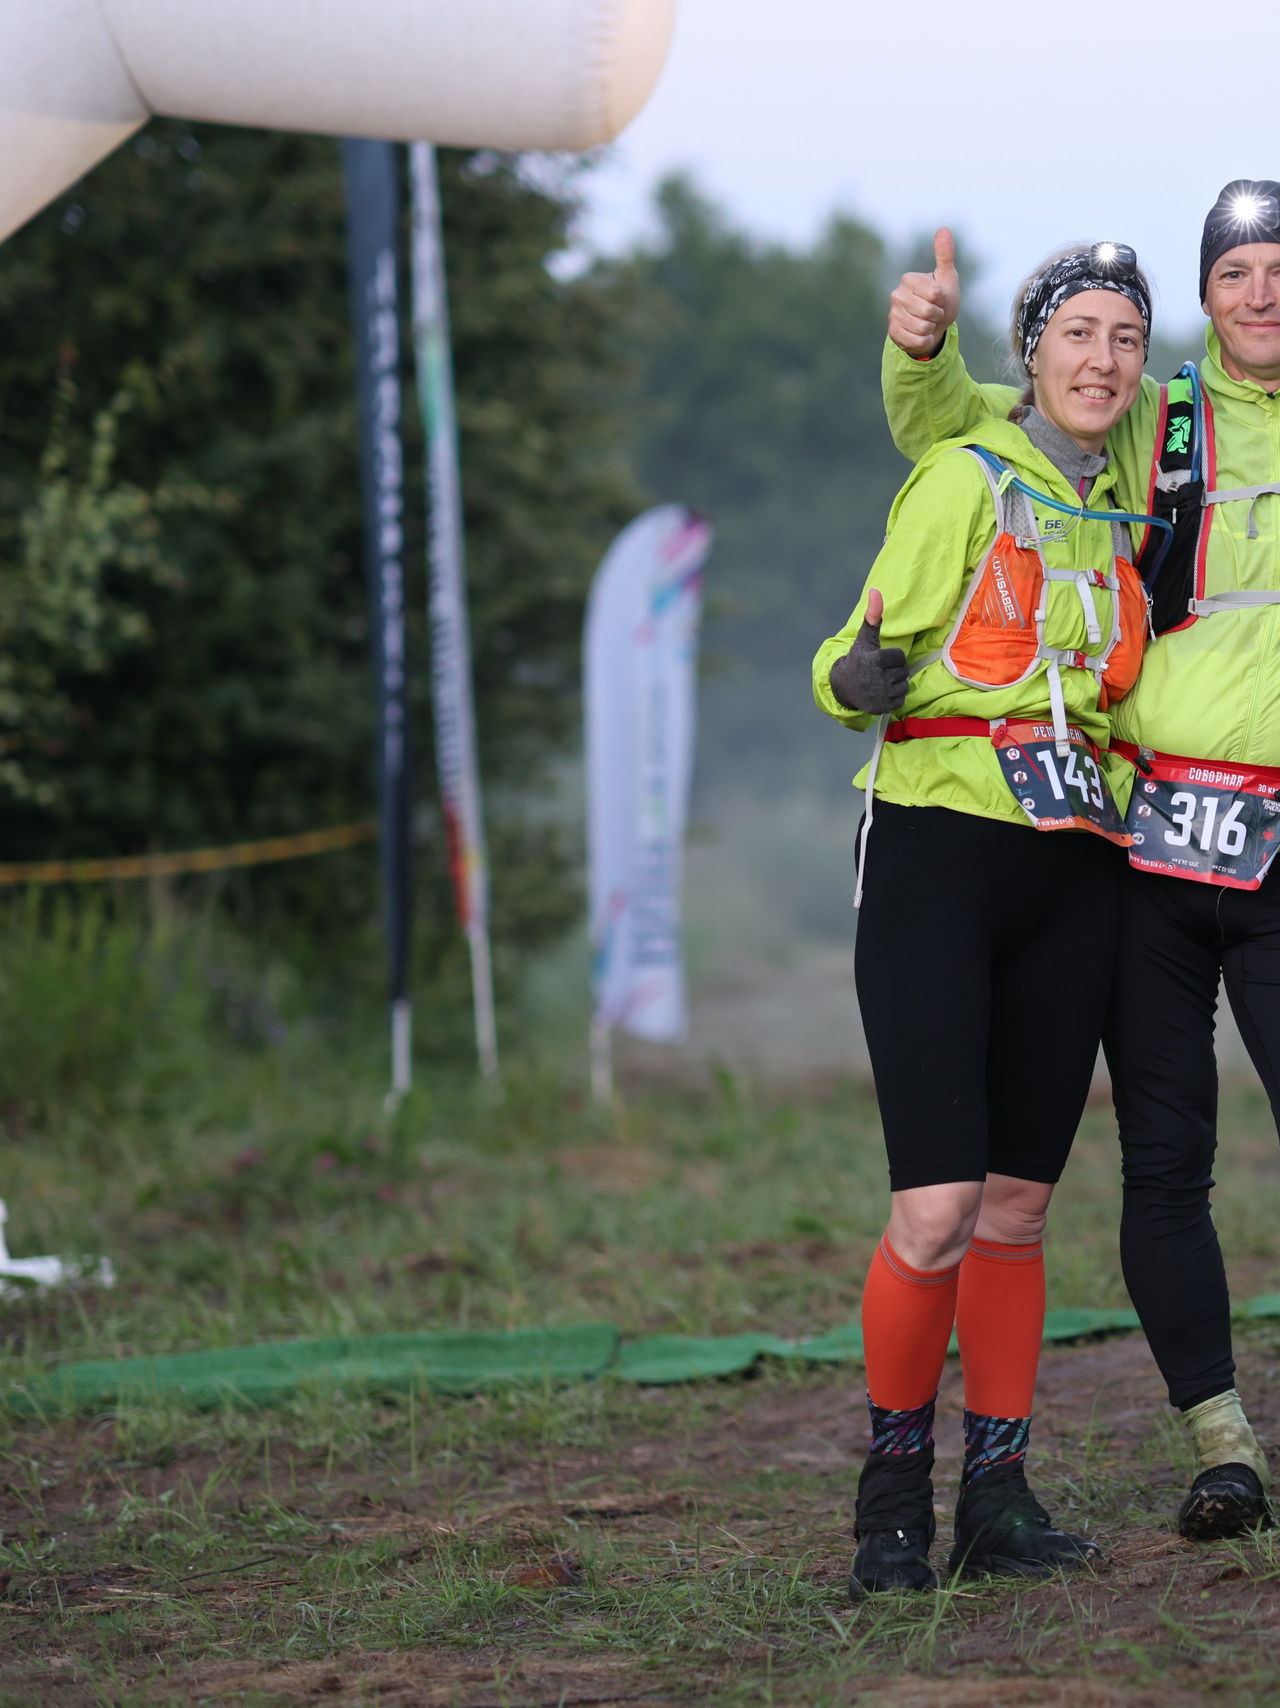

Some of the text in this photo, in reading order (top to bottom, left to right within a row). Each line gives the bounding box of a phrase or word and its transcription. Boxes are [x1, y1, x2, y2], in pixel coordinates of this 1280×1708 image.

[1036, 749, 1104, 811] 143
[1188, 766, 1245, 788] СОБОРНАЯ
[1257, 783, 1267, 793] 30
[1163, 791, 1247, 856] 316
